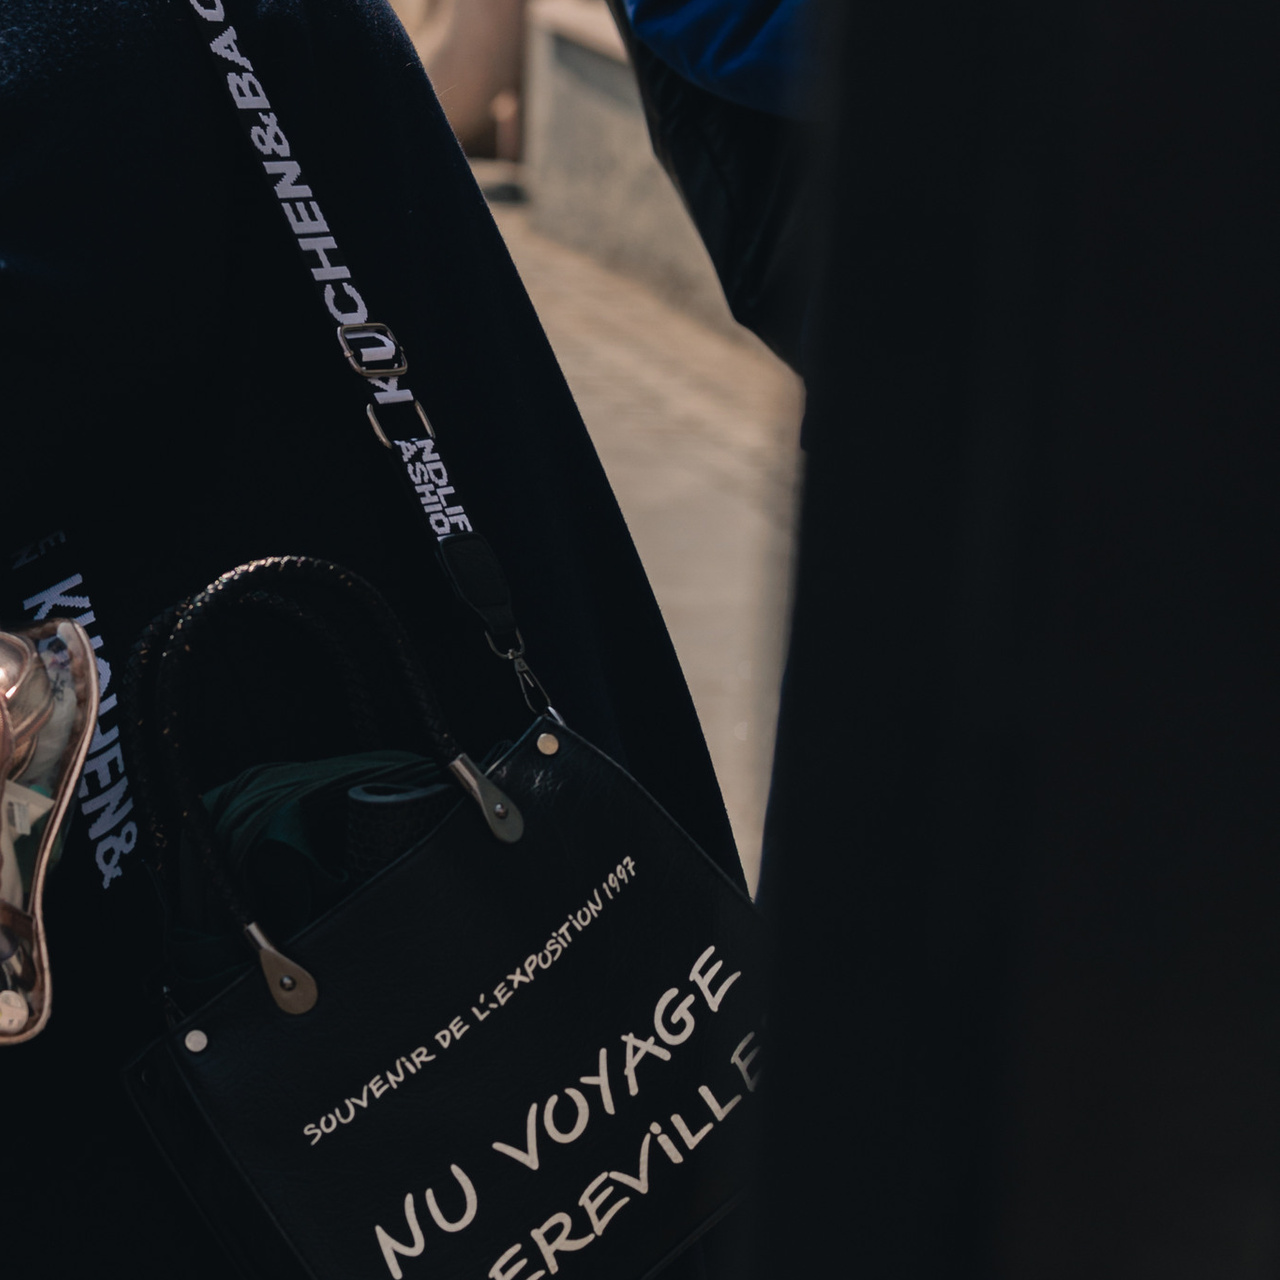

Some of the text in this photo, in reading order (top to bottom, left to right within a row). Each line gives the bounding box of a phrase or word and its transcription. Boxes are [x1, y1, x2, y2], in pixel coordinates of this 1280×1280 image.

[393, 439, 453, 541] ASHIO
[412, 438, 474, 533] NDLIF
[435, 1016, 470, 1049] DE
[602, 856, 637, 901] 1997
[374, 945, 742, 1280] NU VOYAGE
